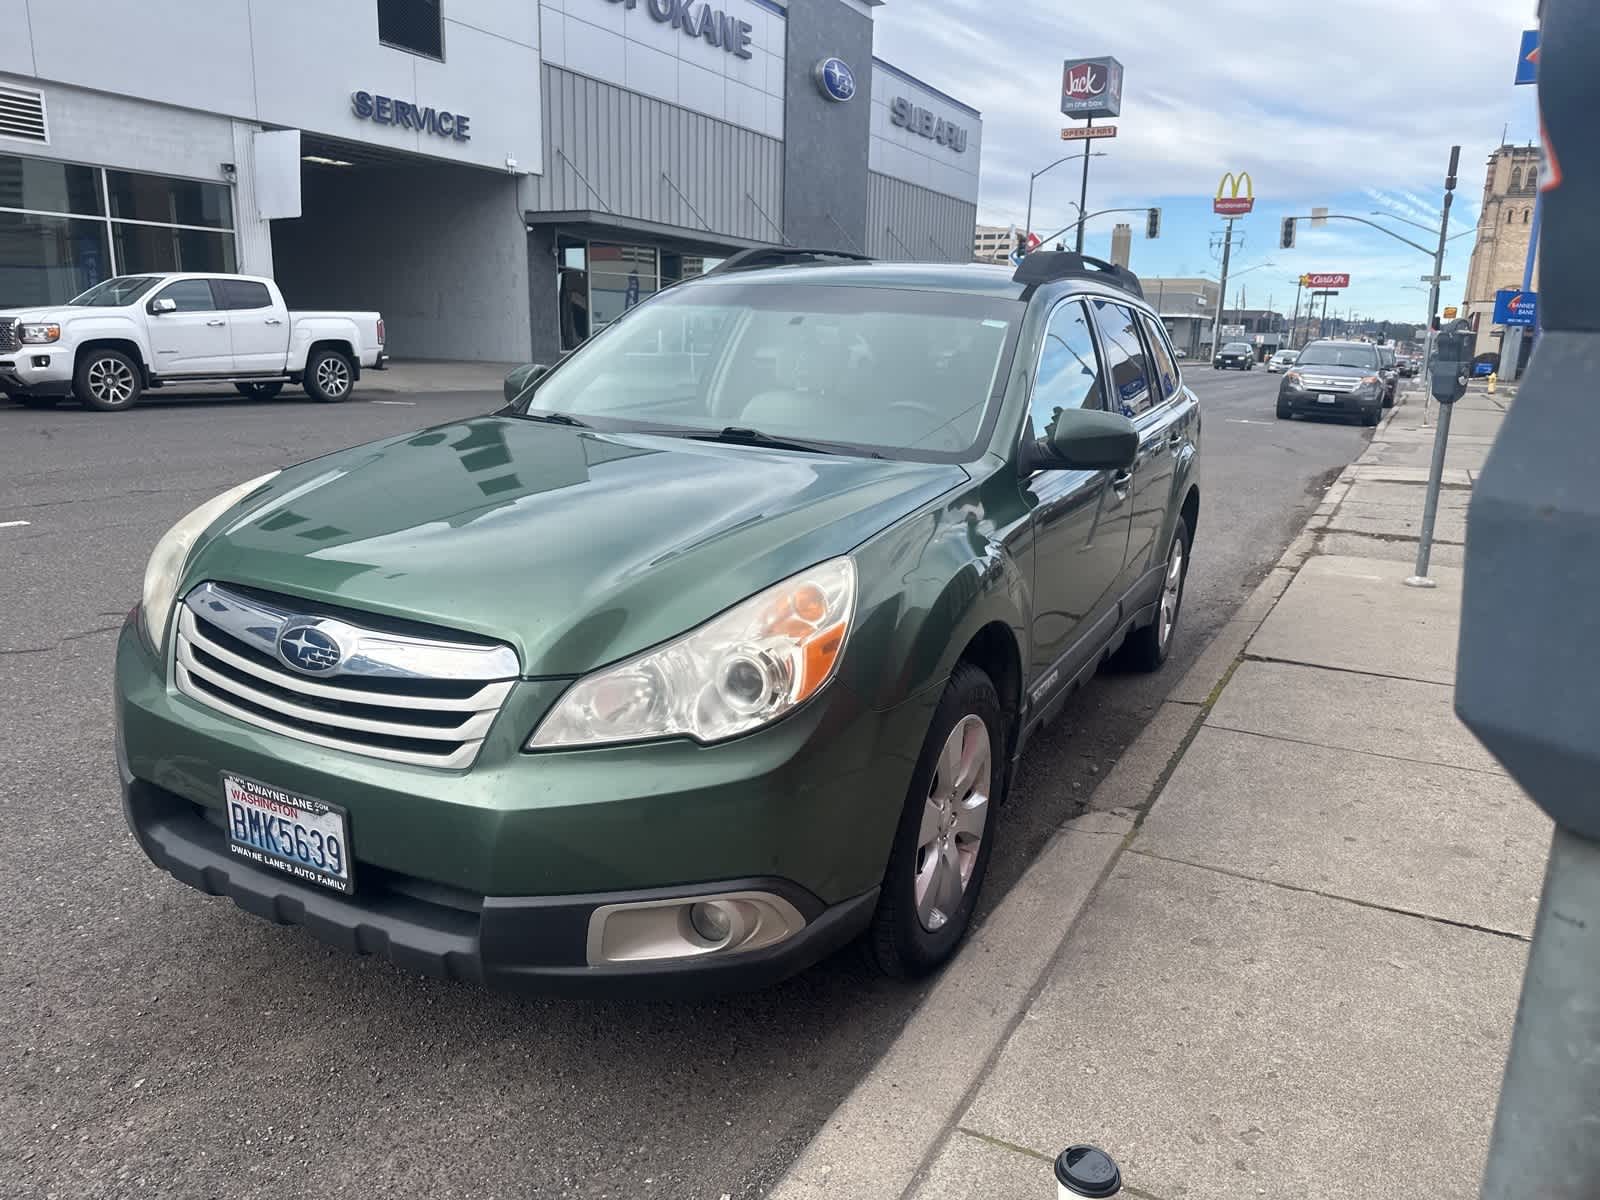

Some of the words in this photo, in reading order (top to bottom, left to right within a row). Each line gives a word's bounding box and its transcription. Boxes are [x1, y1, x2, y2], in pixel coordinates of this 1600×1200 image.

[604, 0, 753, 60] OKANE
[1065, 66, 1106, 96] Jack
[351, 90, 471, 142] SERVICE
[890, 96, 968, 154] SUBARU
[1063, 129, 1085, 138] OPEN
[231, 788, 298, 819] WASHINGTON
[231, 801, 343, 875] BMK5639
[231, 843, 263, 862] DWAYNE
[264, 855, 293, 873] LANE'S
[294, 866, 316, 881] AUTO
[317, 874, 347, 891] FAMILY
